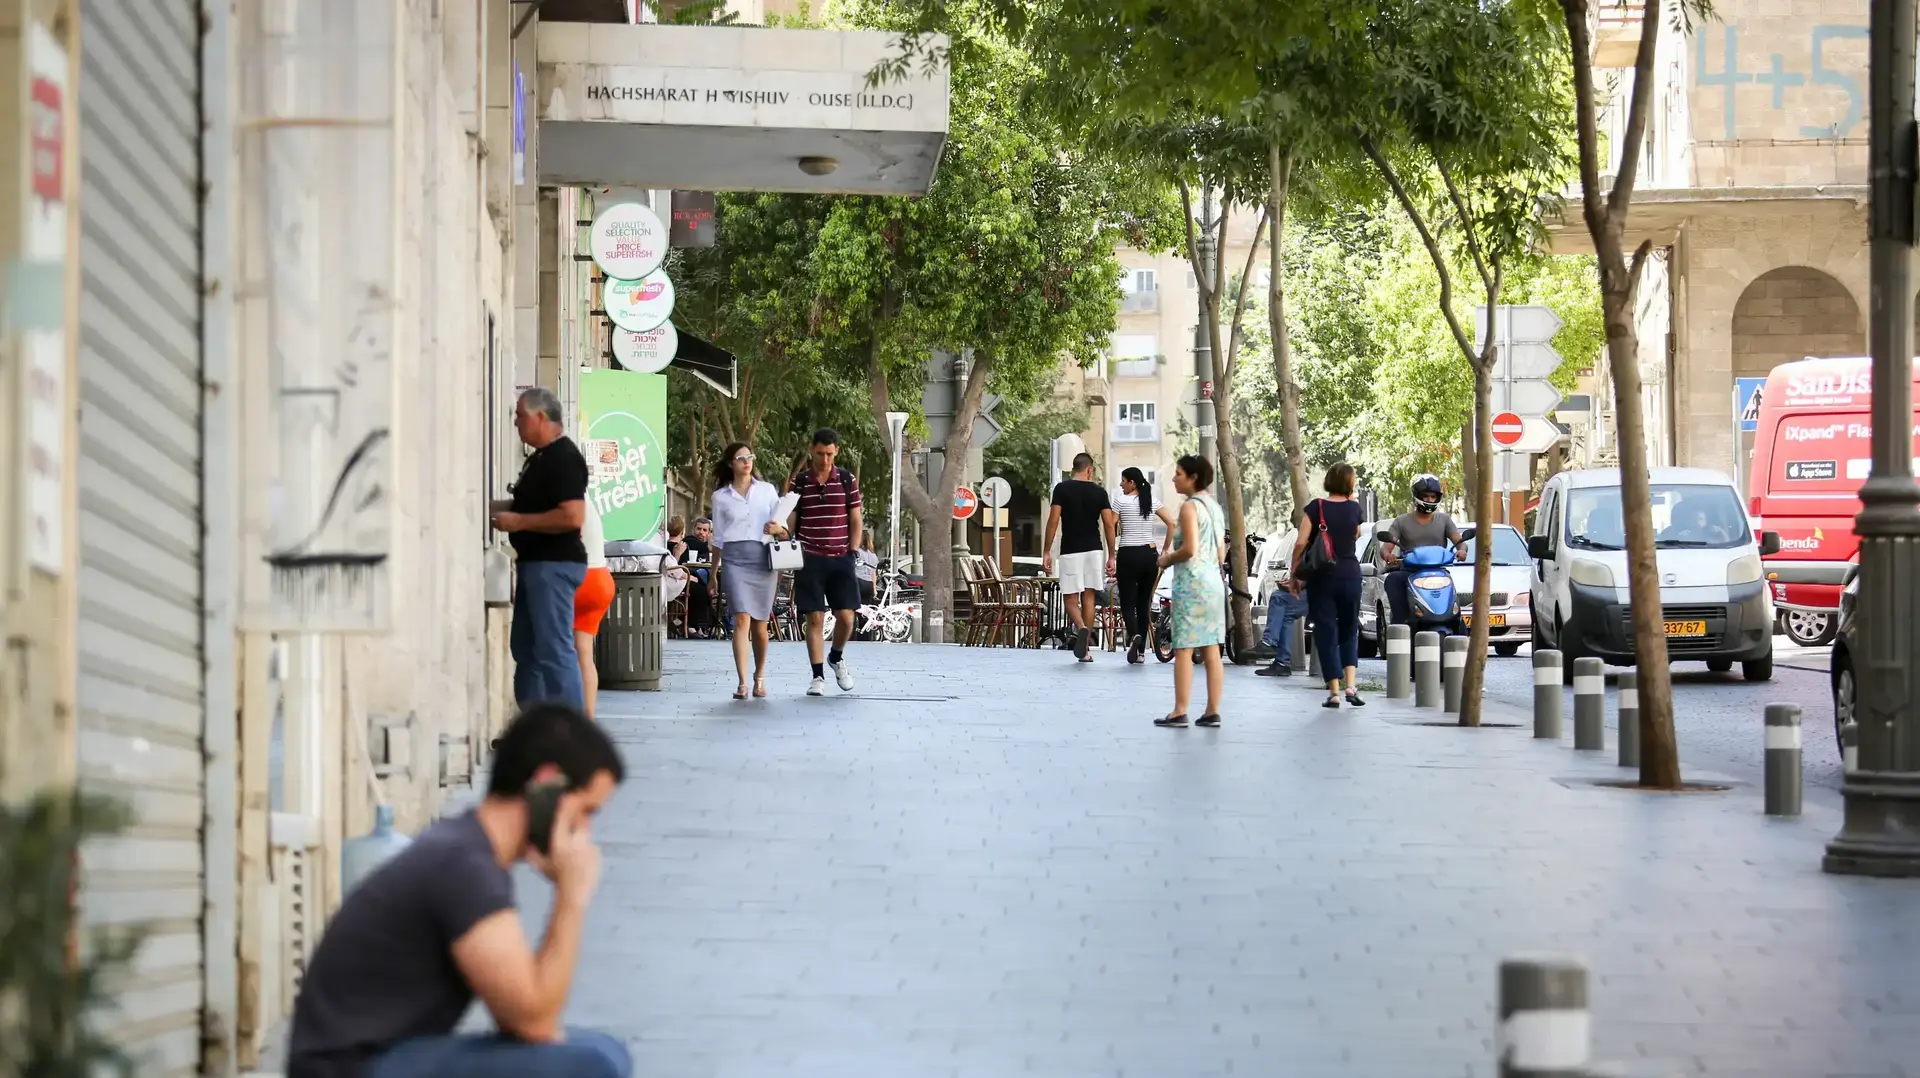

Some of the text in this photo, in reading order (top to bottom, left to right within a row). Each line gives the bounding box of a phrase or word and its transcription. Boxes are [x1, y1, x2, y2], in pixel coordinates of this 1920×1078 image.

[587, 86, 698, 101] HACHSHARAT
[611, 222, 645, 230] QUALITY
[605, 229, 651, 237] SELECTION
[616, 236, 641, 244] VALUE
[616, 243, 641, 251] PRICE
[605, 250, 653, 259] SUPERFRSH
[1785, 373, 1872, 397] SanDis
[1800, 469, 1815, 478] App
[594, 470, 658, 516] fresh.
